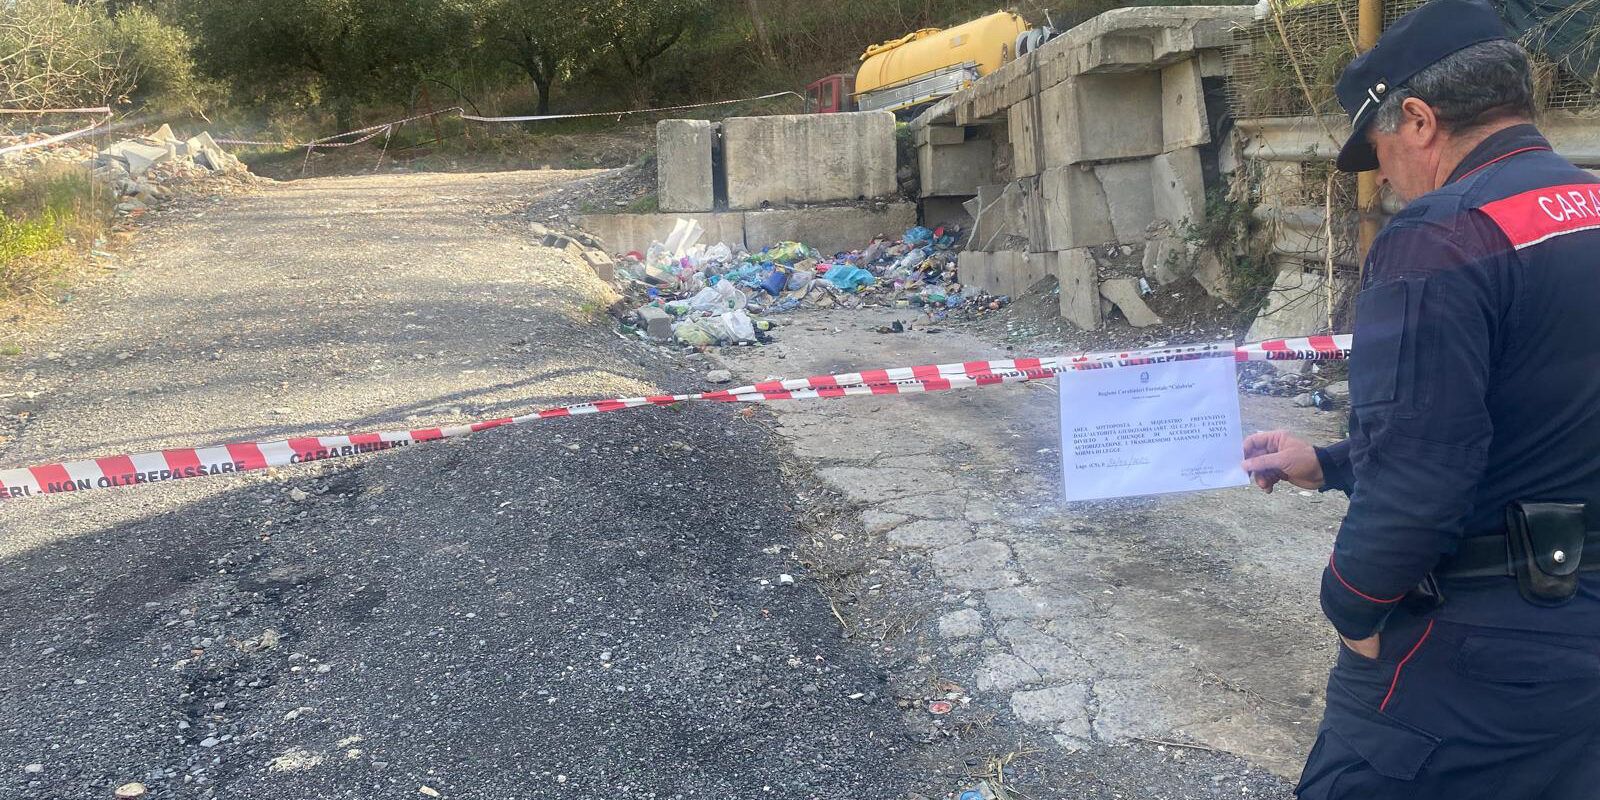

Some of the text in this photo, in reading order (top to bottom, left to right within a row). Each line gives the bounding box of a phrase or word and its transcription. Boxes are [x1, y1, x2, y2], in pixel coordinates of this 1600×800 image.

[1538, 189, 1600, 222] CARA
[1096, 422, 1130, 430] SOTTOPOSTA
[1190, 414, 1226, 422] PREVENTIVO
[48, 478, 92, 494] NON
[97, 461, 247, 488] OLTREPASSARE
